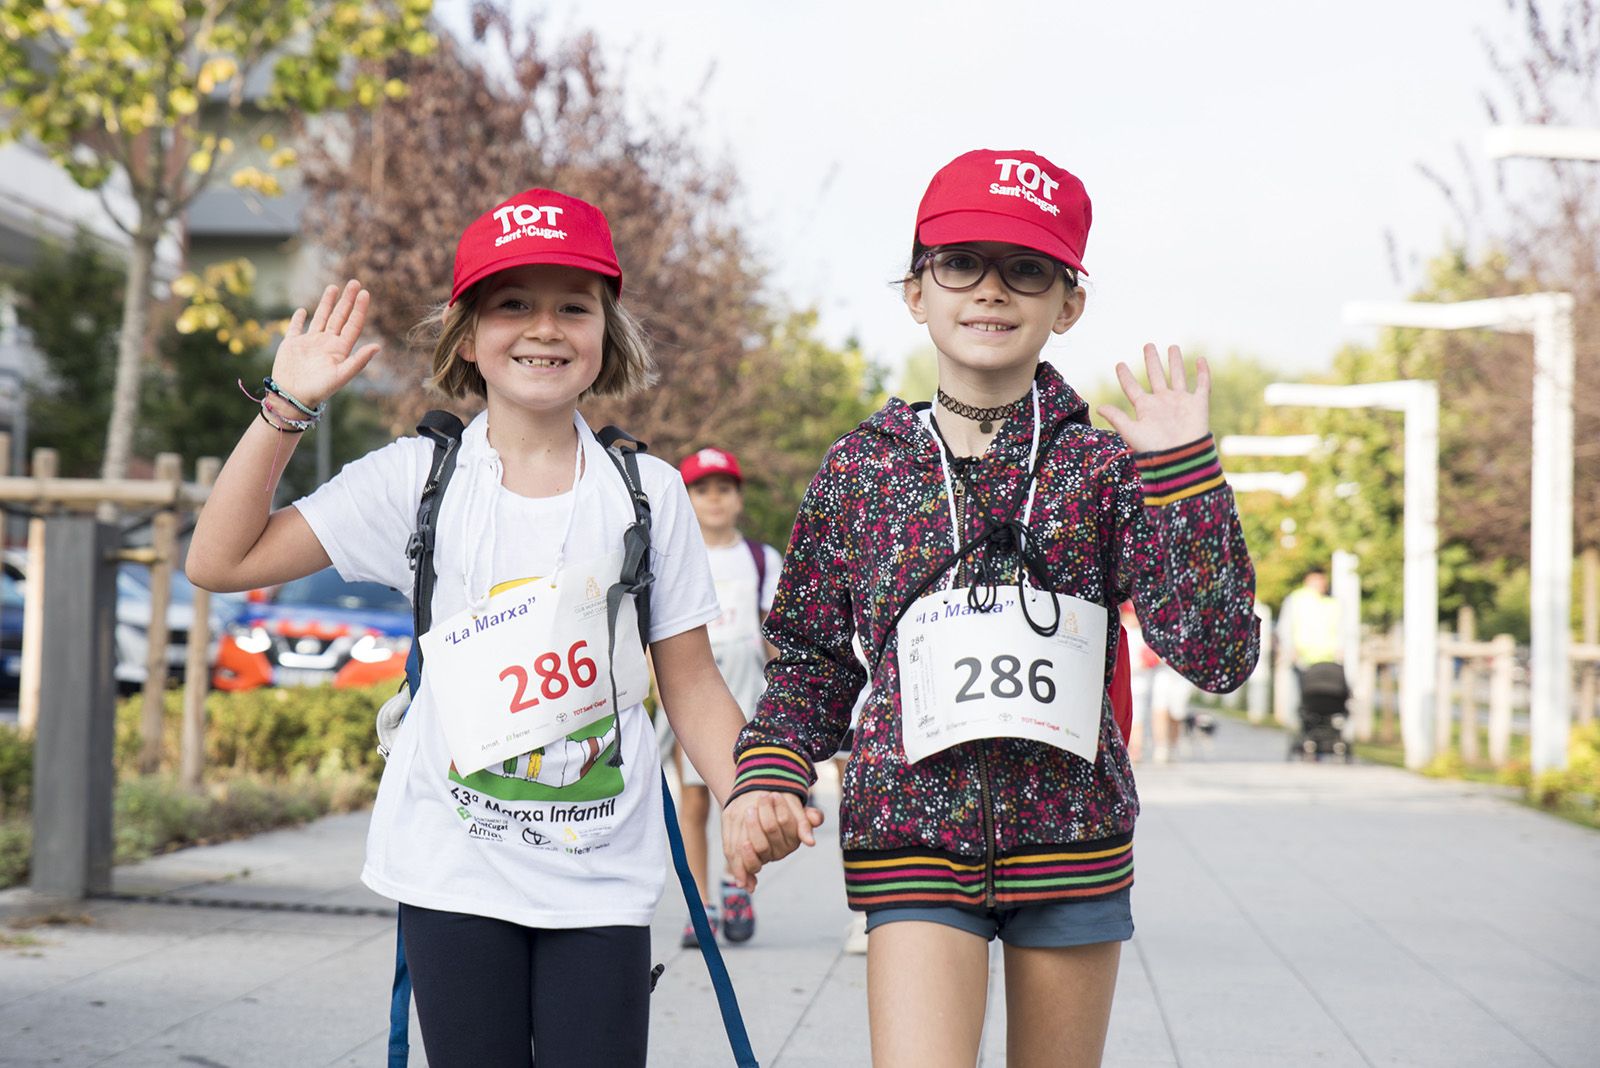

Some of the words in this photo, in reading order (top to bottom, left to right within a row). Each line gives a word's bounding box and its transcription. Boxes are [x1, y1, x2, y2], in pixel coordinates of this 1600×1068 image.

[995, 159, 1059, 200] TOT
[989, 183, 1021, 197] Sant
[1026, 190, 1060, 216] Cugat
[493, 204, 563, 234] TOT
[495, 229, 521, 247] Sant
[527, 225, 567, 240] Cugat
[498, 640, 597, 714] 286
[954, 654, 1056, 704] 286
[550, 798, 616, 822] Infantil
